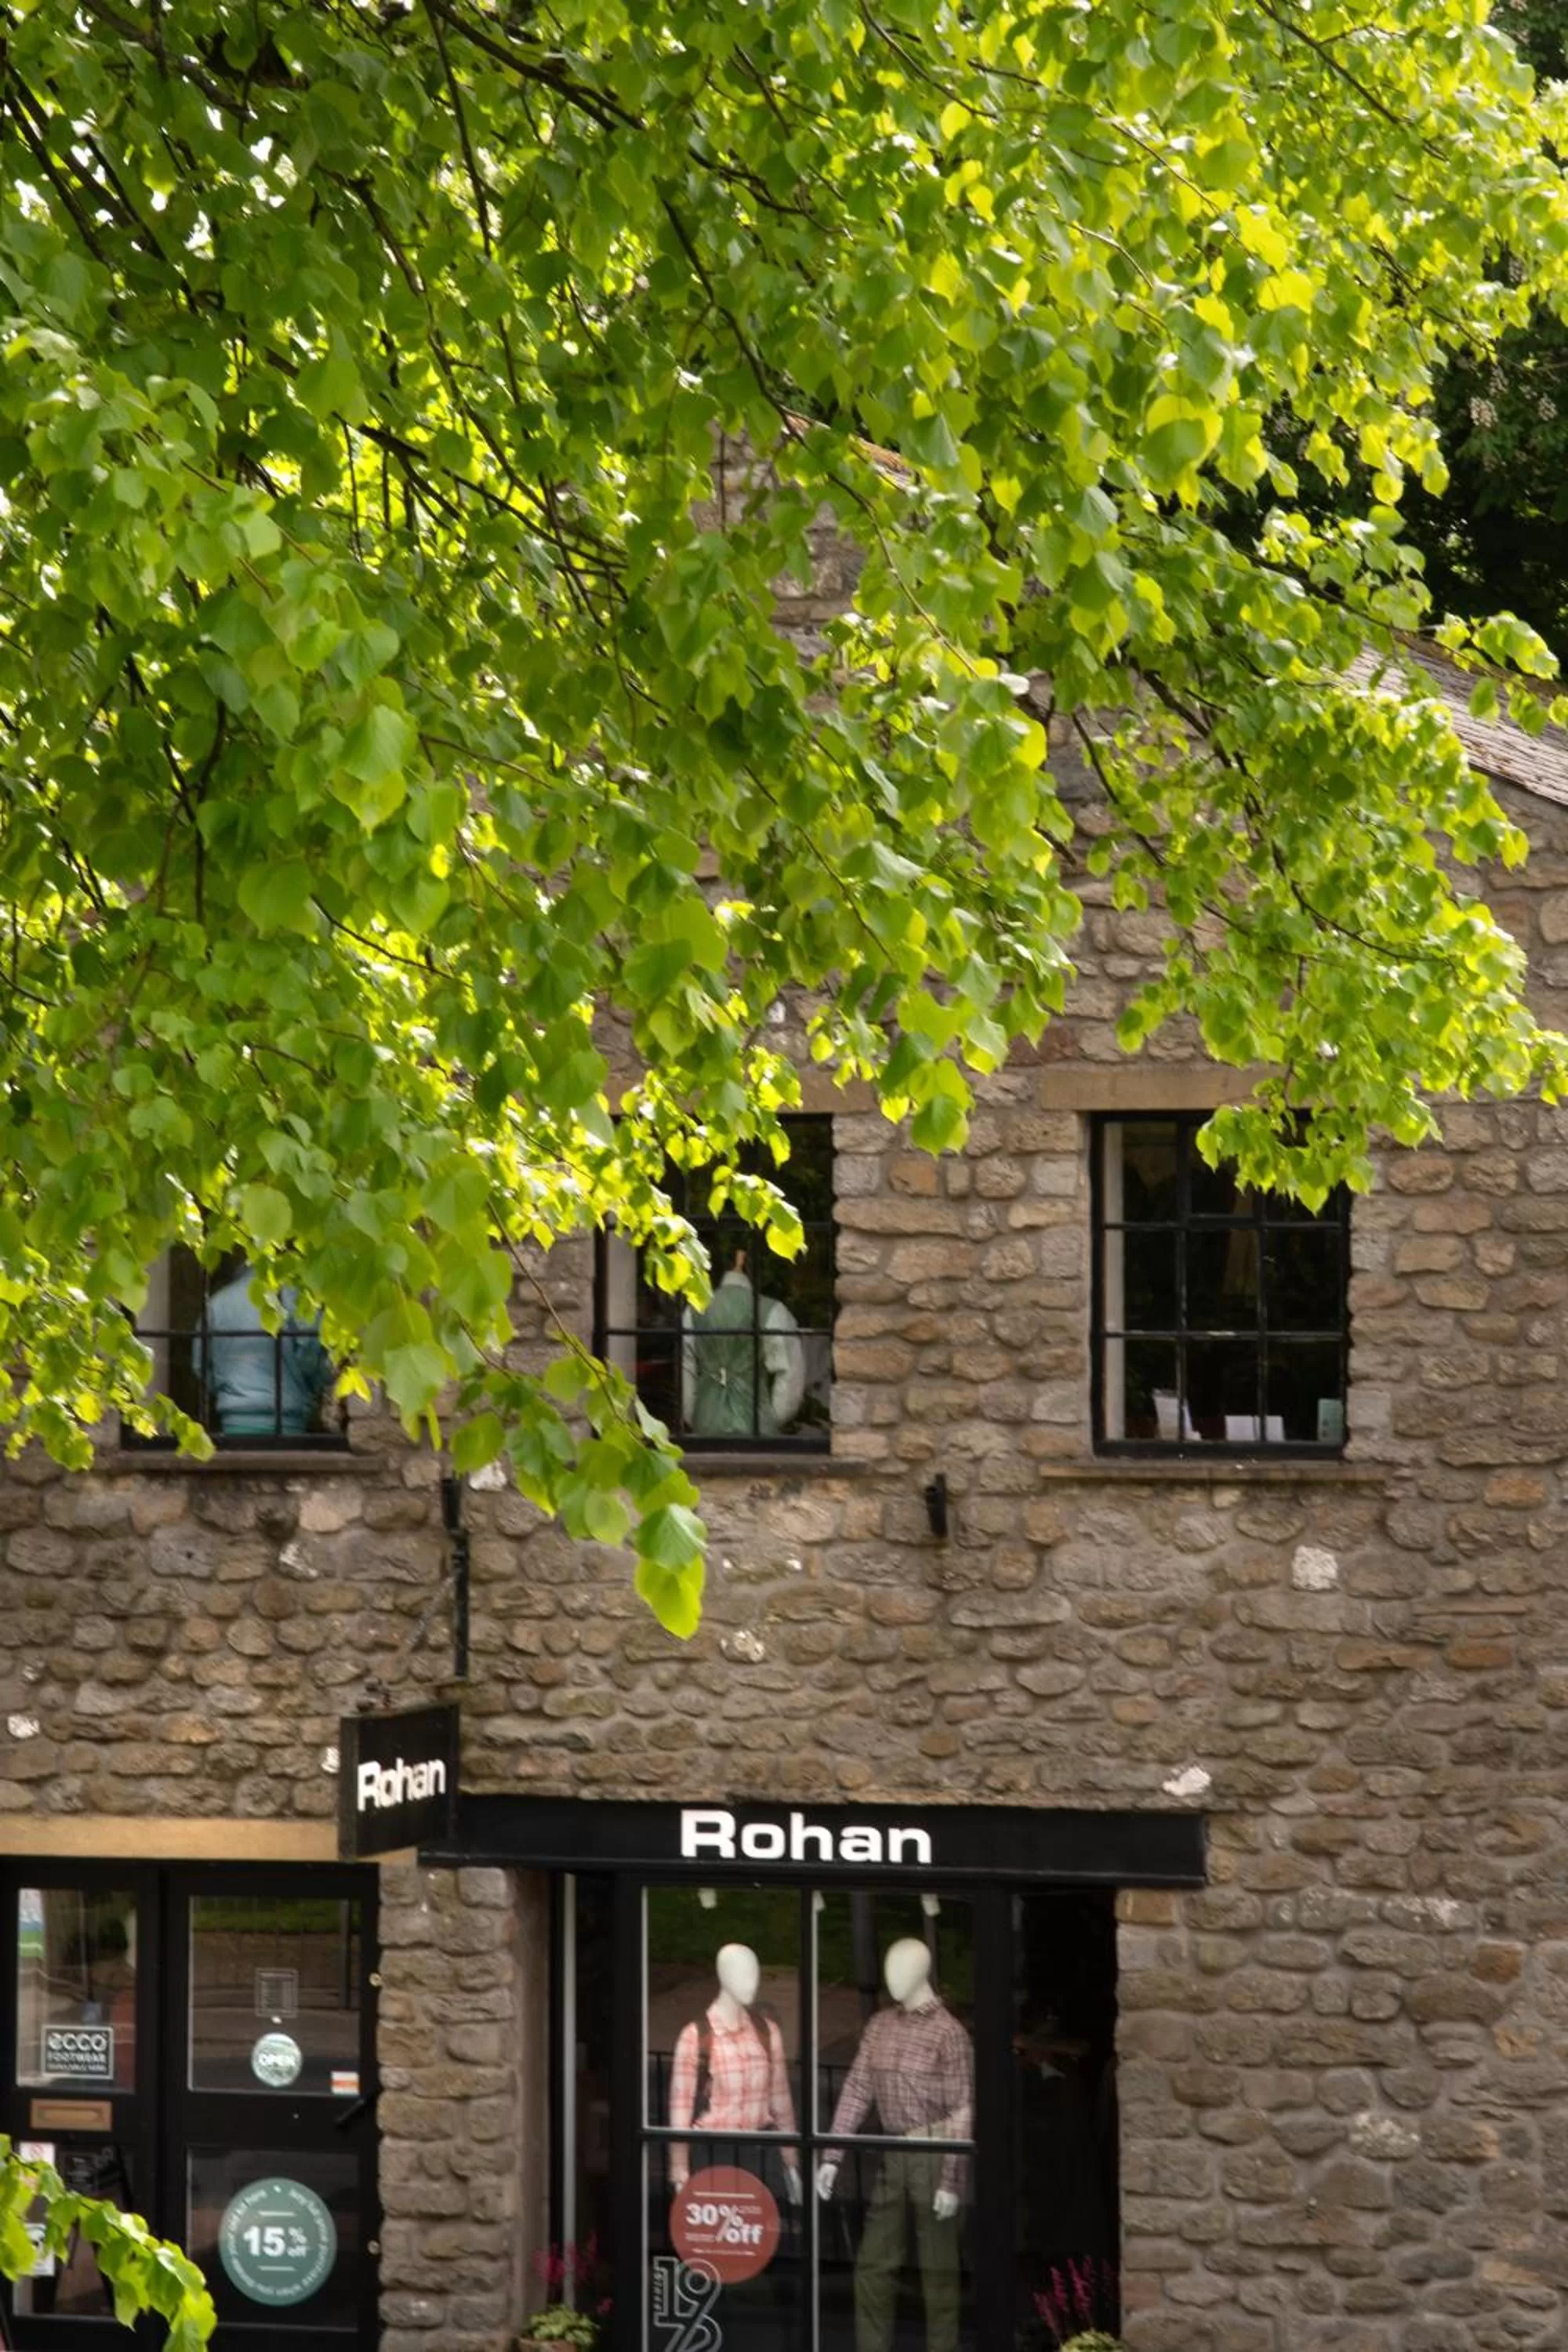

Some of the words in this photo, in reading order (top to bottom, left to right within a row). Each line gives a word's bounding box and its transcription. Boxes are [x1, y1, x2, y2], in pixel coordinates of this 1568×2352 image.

[358, 1758, 446, 1812] Rohan
[681, 1809, 931, 1864] Rohan
[258, 2053, 296, 2067] OPEN
[685, 2203, 743, 2242] 30%
[725, 2224, 764, 2245] off
